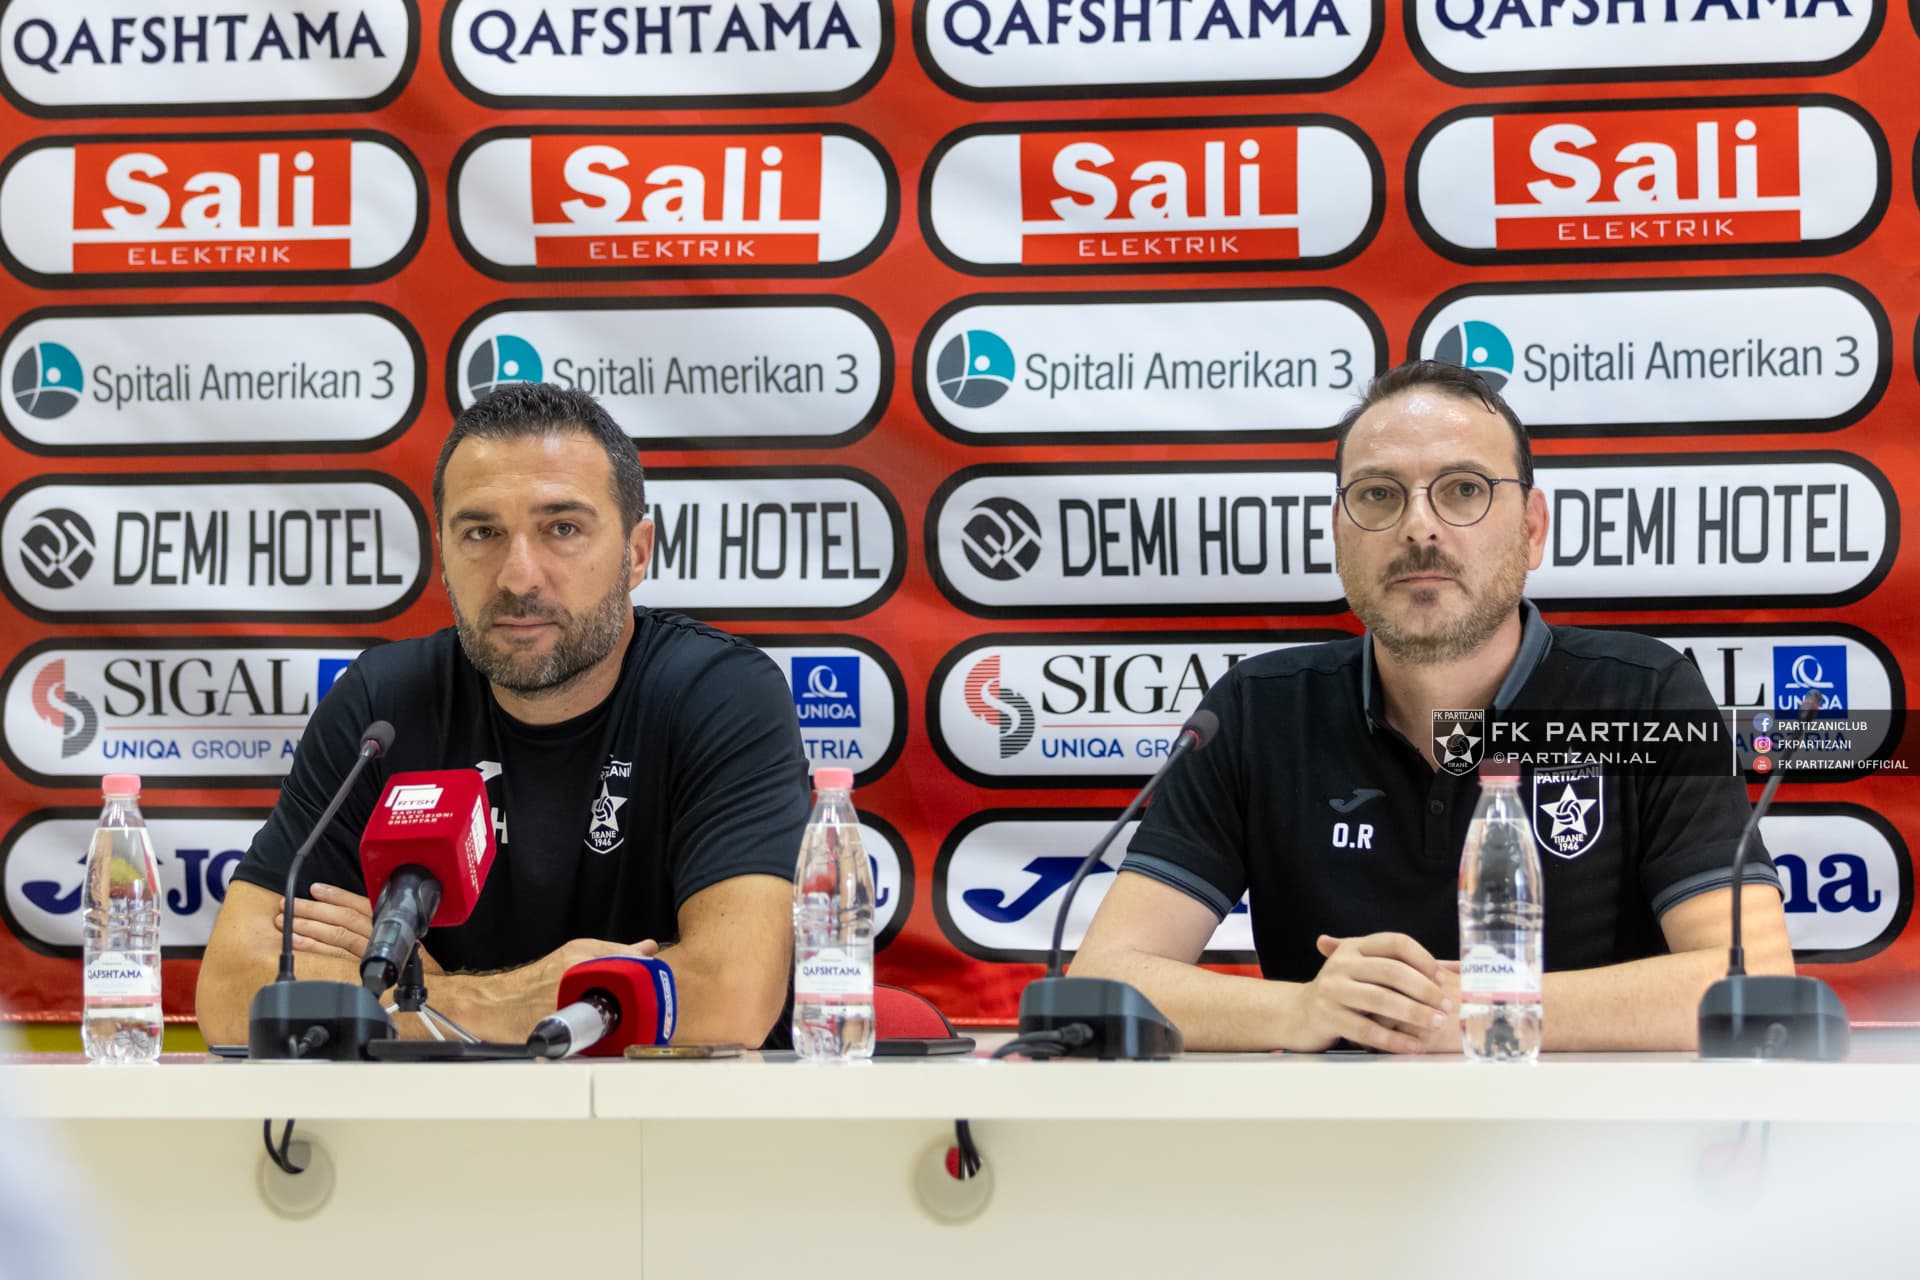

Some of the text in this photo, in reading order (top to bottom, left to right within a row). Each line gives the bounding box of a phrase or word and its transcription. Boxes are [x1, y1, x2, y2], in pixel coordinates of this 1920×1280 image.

[14, 10, 386, 73] QAFSHTAMA
[470, 1, 862, 63] QAFSHTAMA
[944, 0, 1350, 54] QAFSHTAMA
[560, 145, 783, 224] Sali
[1050, 139, 1259, 221] Sali
[1526, 119, 1758, 205] Sali
[101, 151, 314, 230] Sali
[589, 239, 755, 259] ELEKTRIK
[1078, 235, 1239, 257] ELEKTRIK
[1557, 218, 1734, 241] ELEKTRIK
[128, 246, 291, 265] ELEKTRIK
[92, 360, 395, 410] Spitali Amerikan 3
[553, 353, 859, 396] Spitali Amerikan 3
[1025, 349, 1353, 399] Spitali Amerikan 3
[1523, 336, 1860, 391] Spitali Amerikan 3
[113, 509, 403, 586] DEMI HOTEL
[644, 501, 880, 580] MI HOTEL
[1059, 496, 1338, 577] DEMI HOTE
[1553, 484, 1869, 567] DEMI HOTEL
[103, 658, 309, 718] SIGAL
[1042, 653, 1247, 715] SIGA
[1778, 694, 1843, 711] UNQA
[796, 703, 857, 720] UNIQA
[103, 739, 181, 760] UNIQA
[192, 739, 271, 759] GROUP
[805, 739, 863, 759] TRIA
[1042, 738, 1124, 759] UNIQA
[1536, 766, 1599, 784] PARTIZANI
[1332, 823, 1374, 850] O.R
[1554, 834, 1584, 844] TIRANE
[1559, 842, 1579, 851] 1946
[802, 966, 861, 976] QAFSHTAMA
